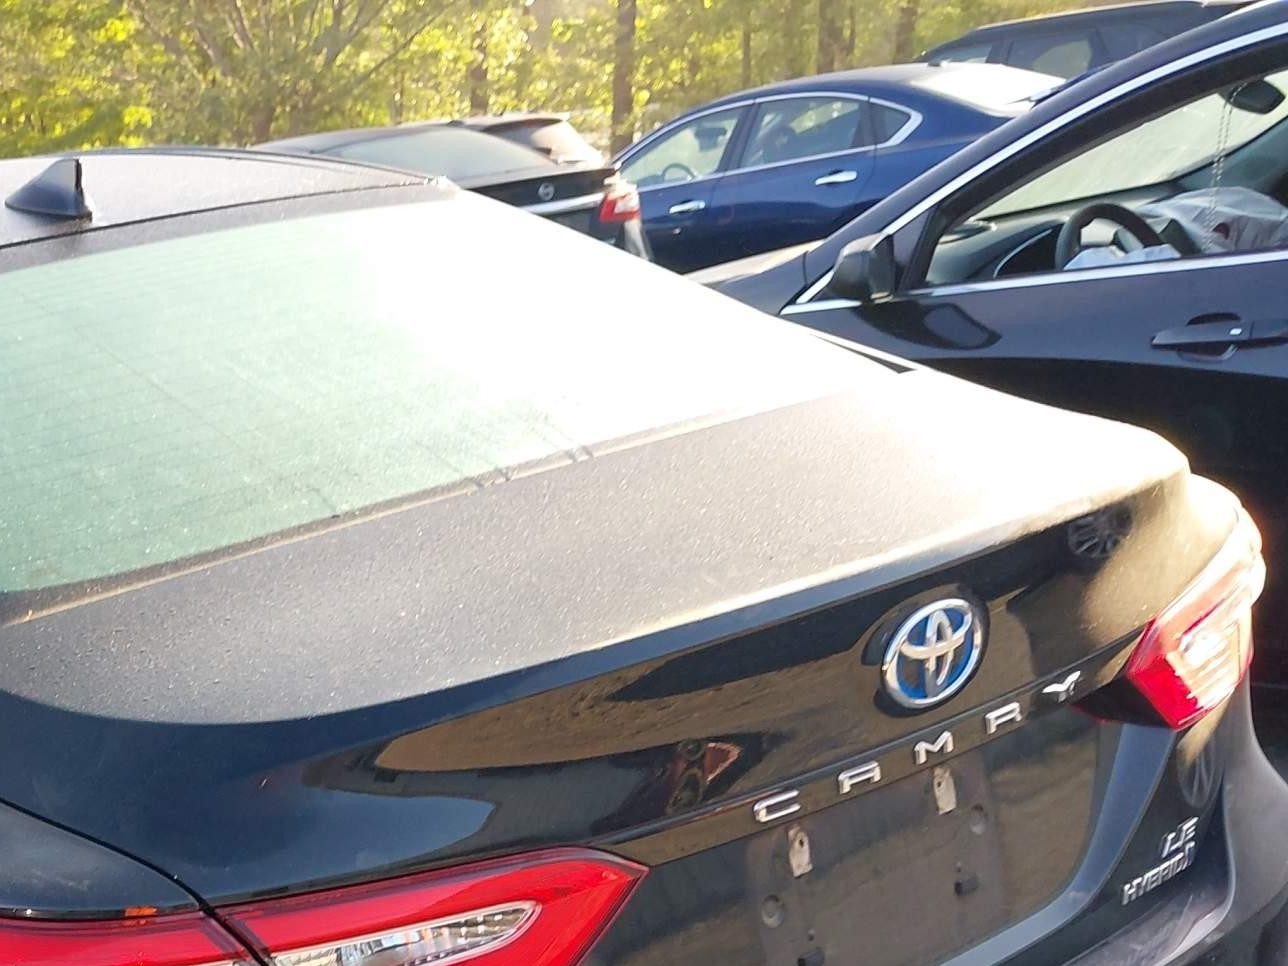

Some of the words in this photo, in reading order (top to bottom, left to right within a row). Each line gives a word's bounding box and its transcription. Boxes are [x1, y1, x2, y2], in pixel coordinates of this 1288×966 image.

[753, 669, 1081, 823] CAMRY
[1161, 816, 1199, 858] LE
[1121, 841, 1196, 906] HYBRID
